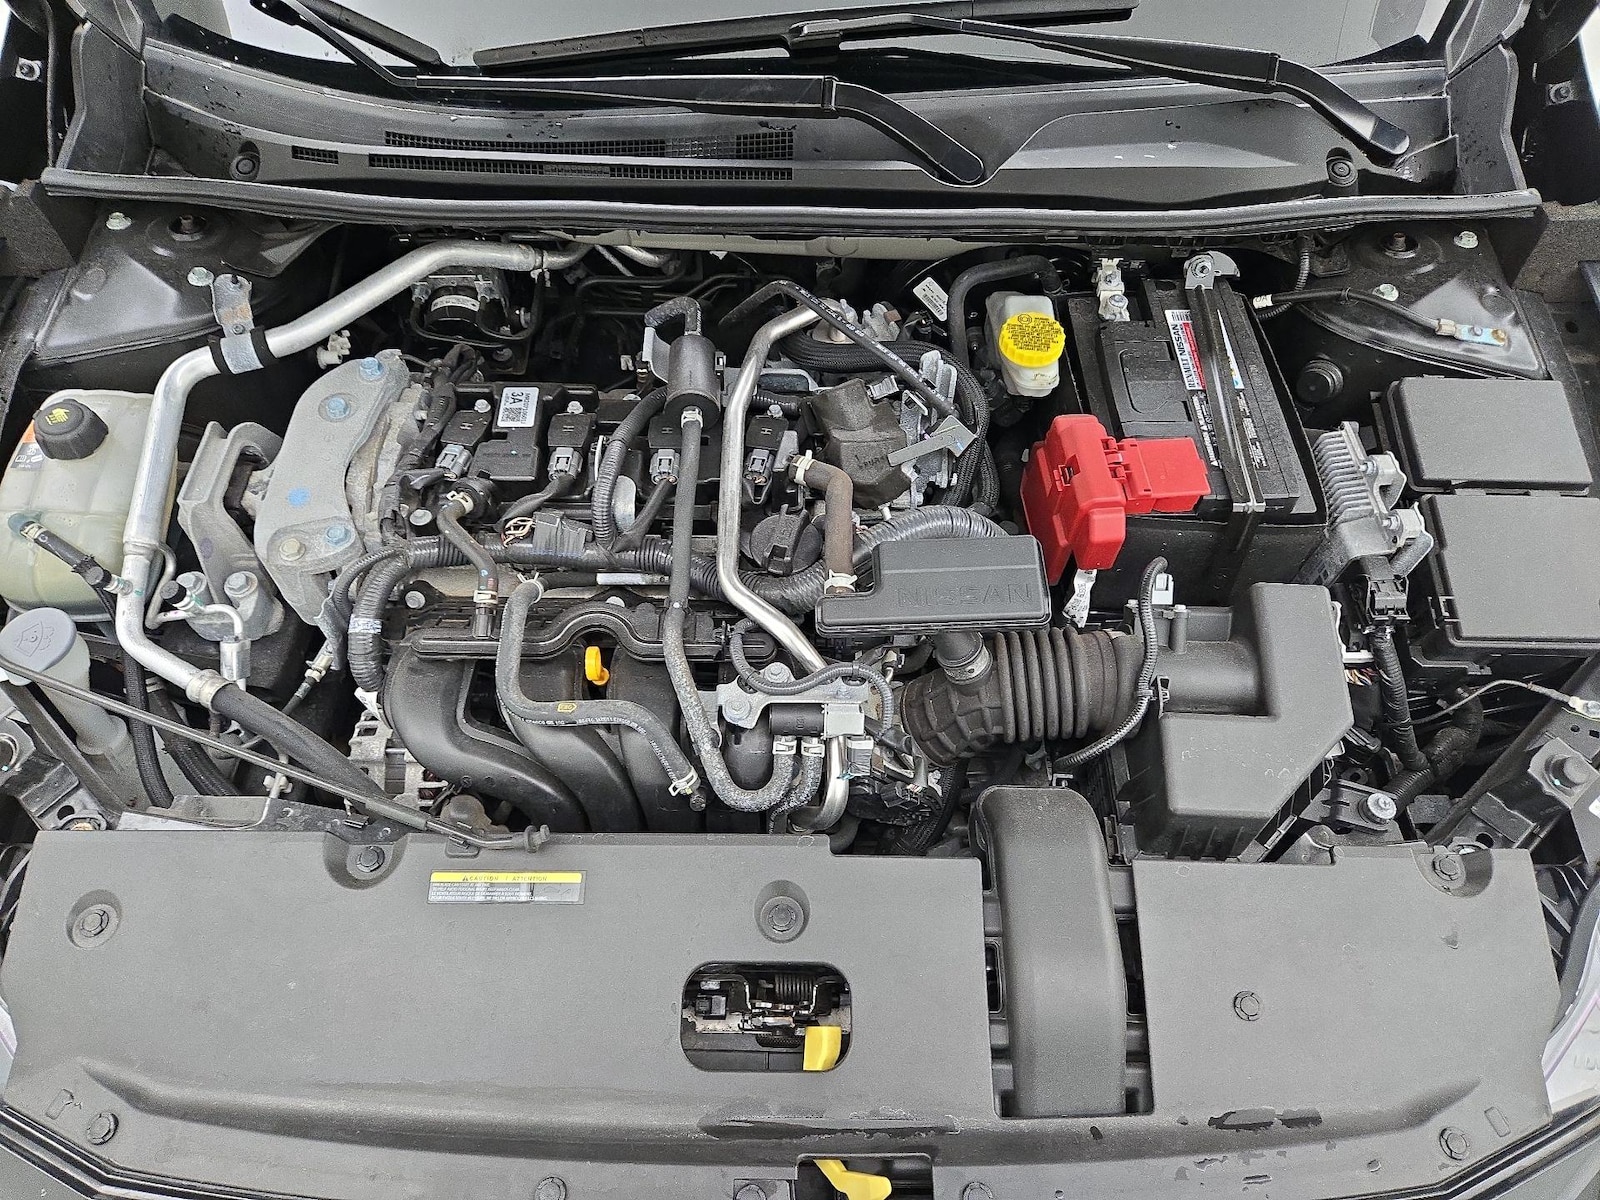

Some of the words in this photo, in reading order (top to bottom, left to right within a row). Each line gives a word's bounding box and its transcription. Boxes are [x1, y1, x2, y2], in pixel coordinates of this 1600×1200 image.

[1171, 323, 1186, 356] NISSAN
[1181, 357, 1196, 388] RENAULT
[509, 391, 524, 405] 3A
[898, 583, 1032, 607] NISSAN
